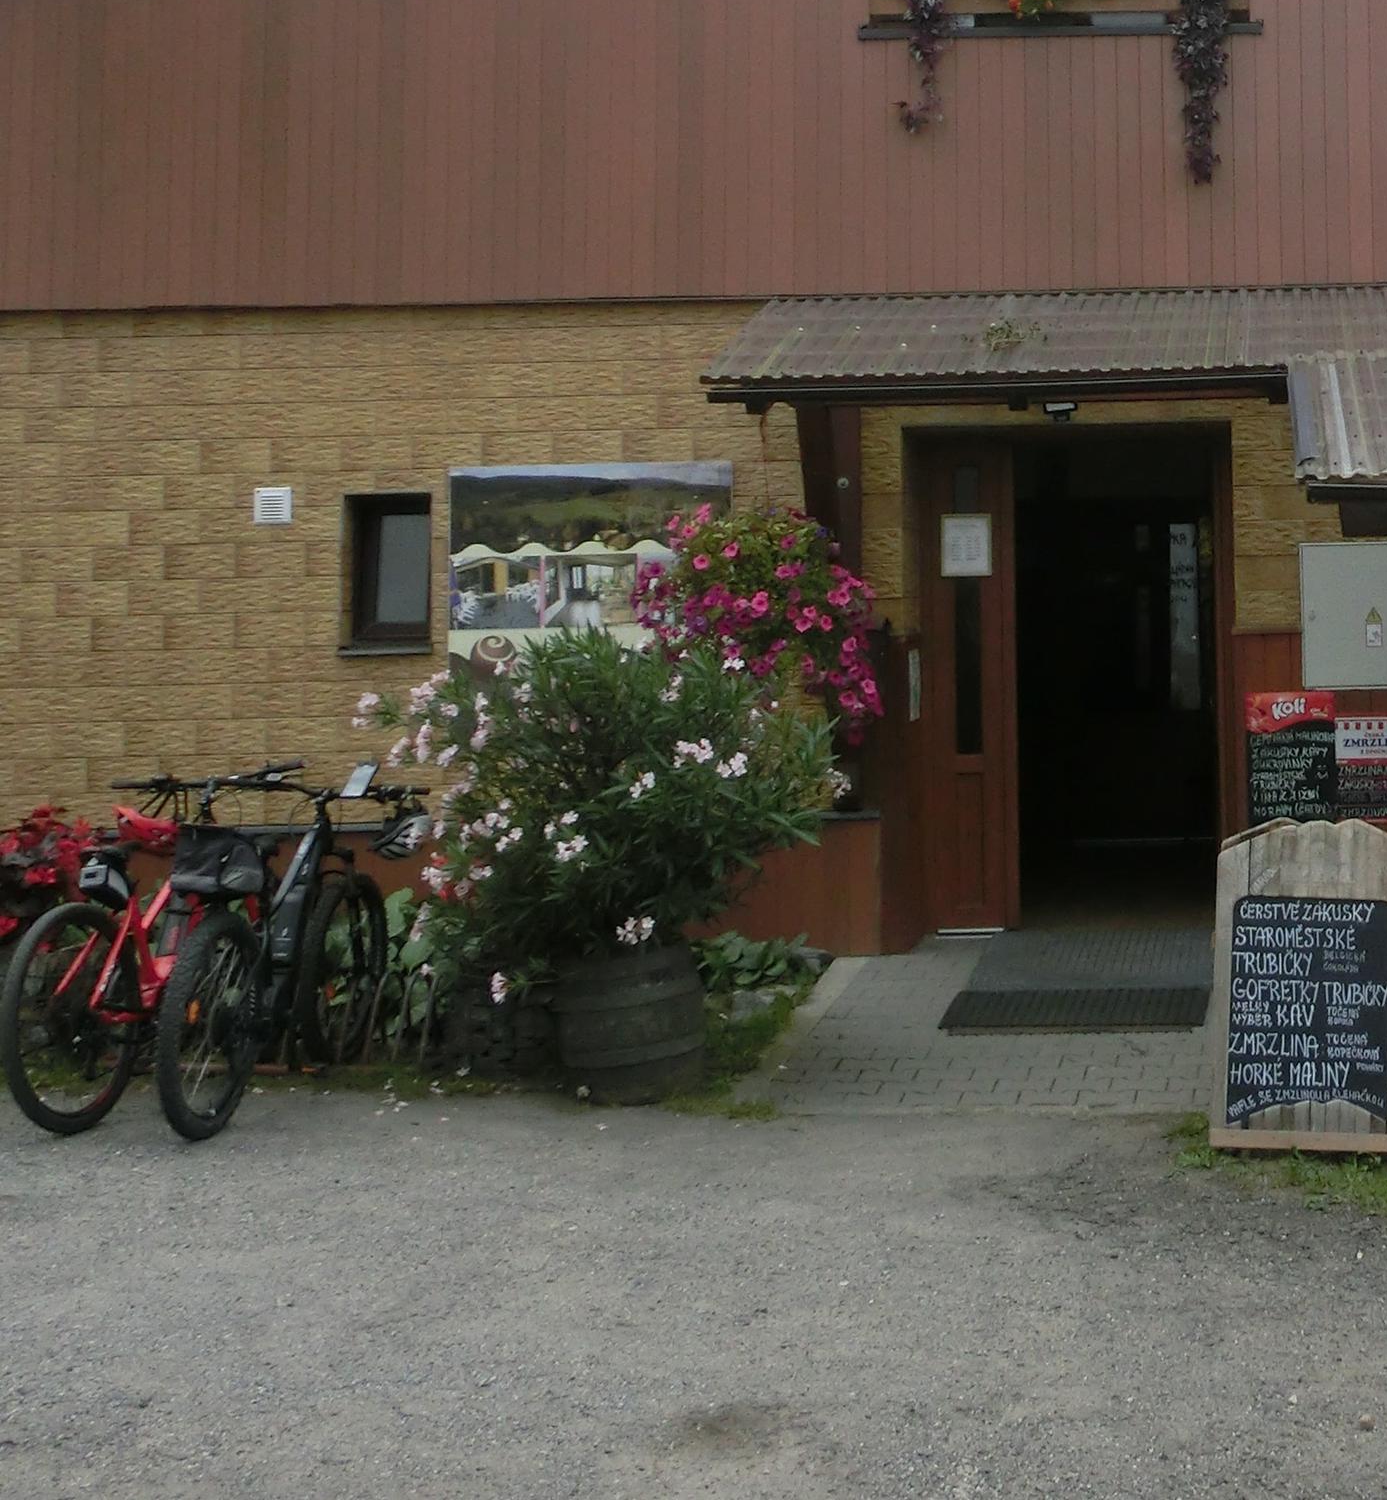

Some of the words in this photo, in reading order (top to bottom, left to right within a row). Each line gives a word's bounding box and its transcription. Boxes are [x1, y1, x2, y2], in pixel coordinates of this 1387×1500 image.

[1240, 900, 1300, 920] ČERSTVÉ
[1301, 901, 1376, 923] ZÁKUSKY
[1234, 925, 1357, 950] STAROMĚSTSKÉ
[1232, 949, 1313, 977] TRUBIČKY
[1232, 977, 1320, 1003] GOFRETKY
[1276, 999, 1315, 1027] KÁV
[1230, 1057, 1284, 1086] HORKÉ
[1289, 1060, 1350, 1088] MALINY
[1257, 1089, 1274, 1104] SE
